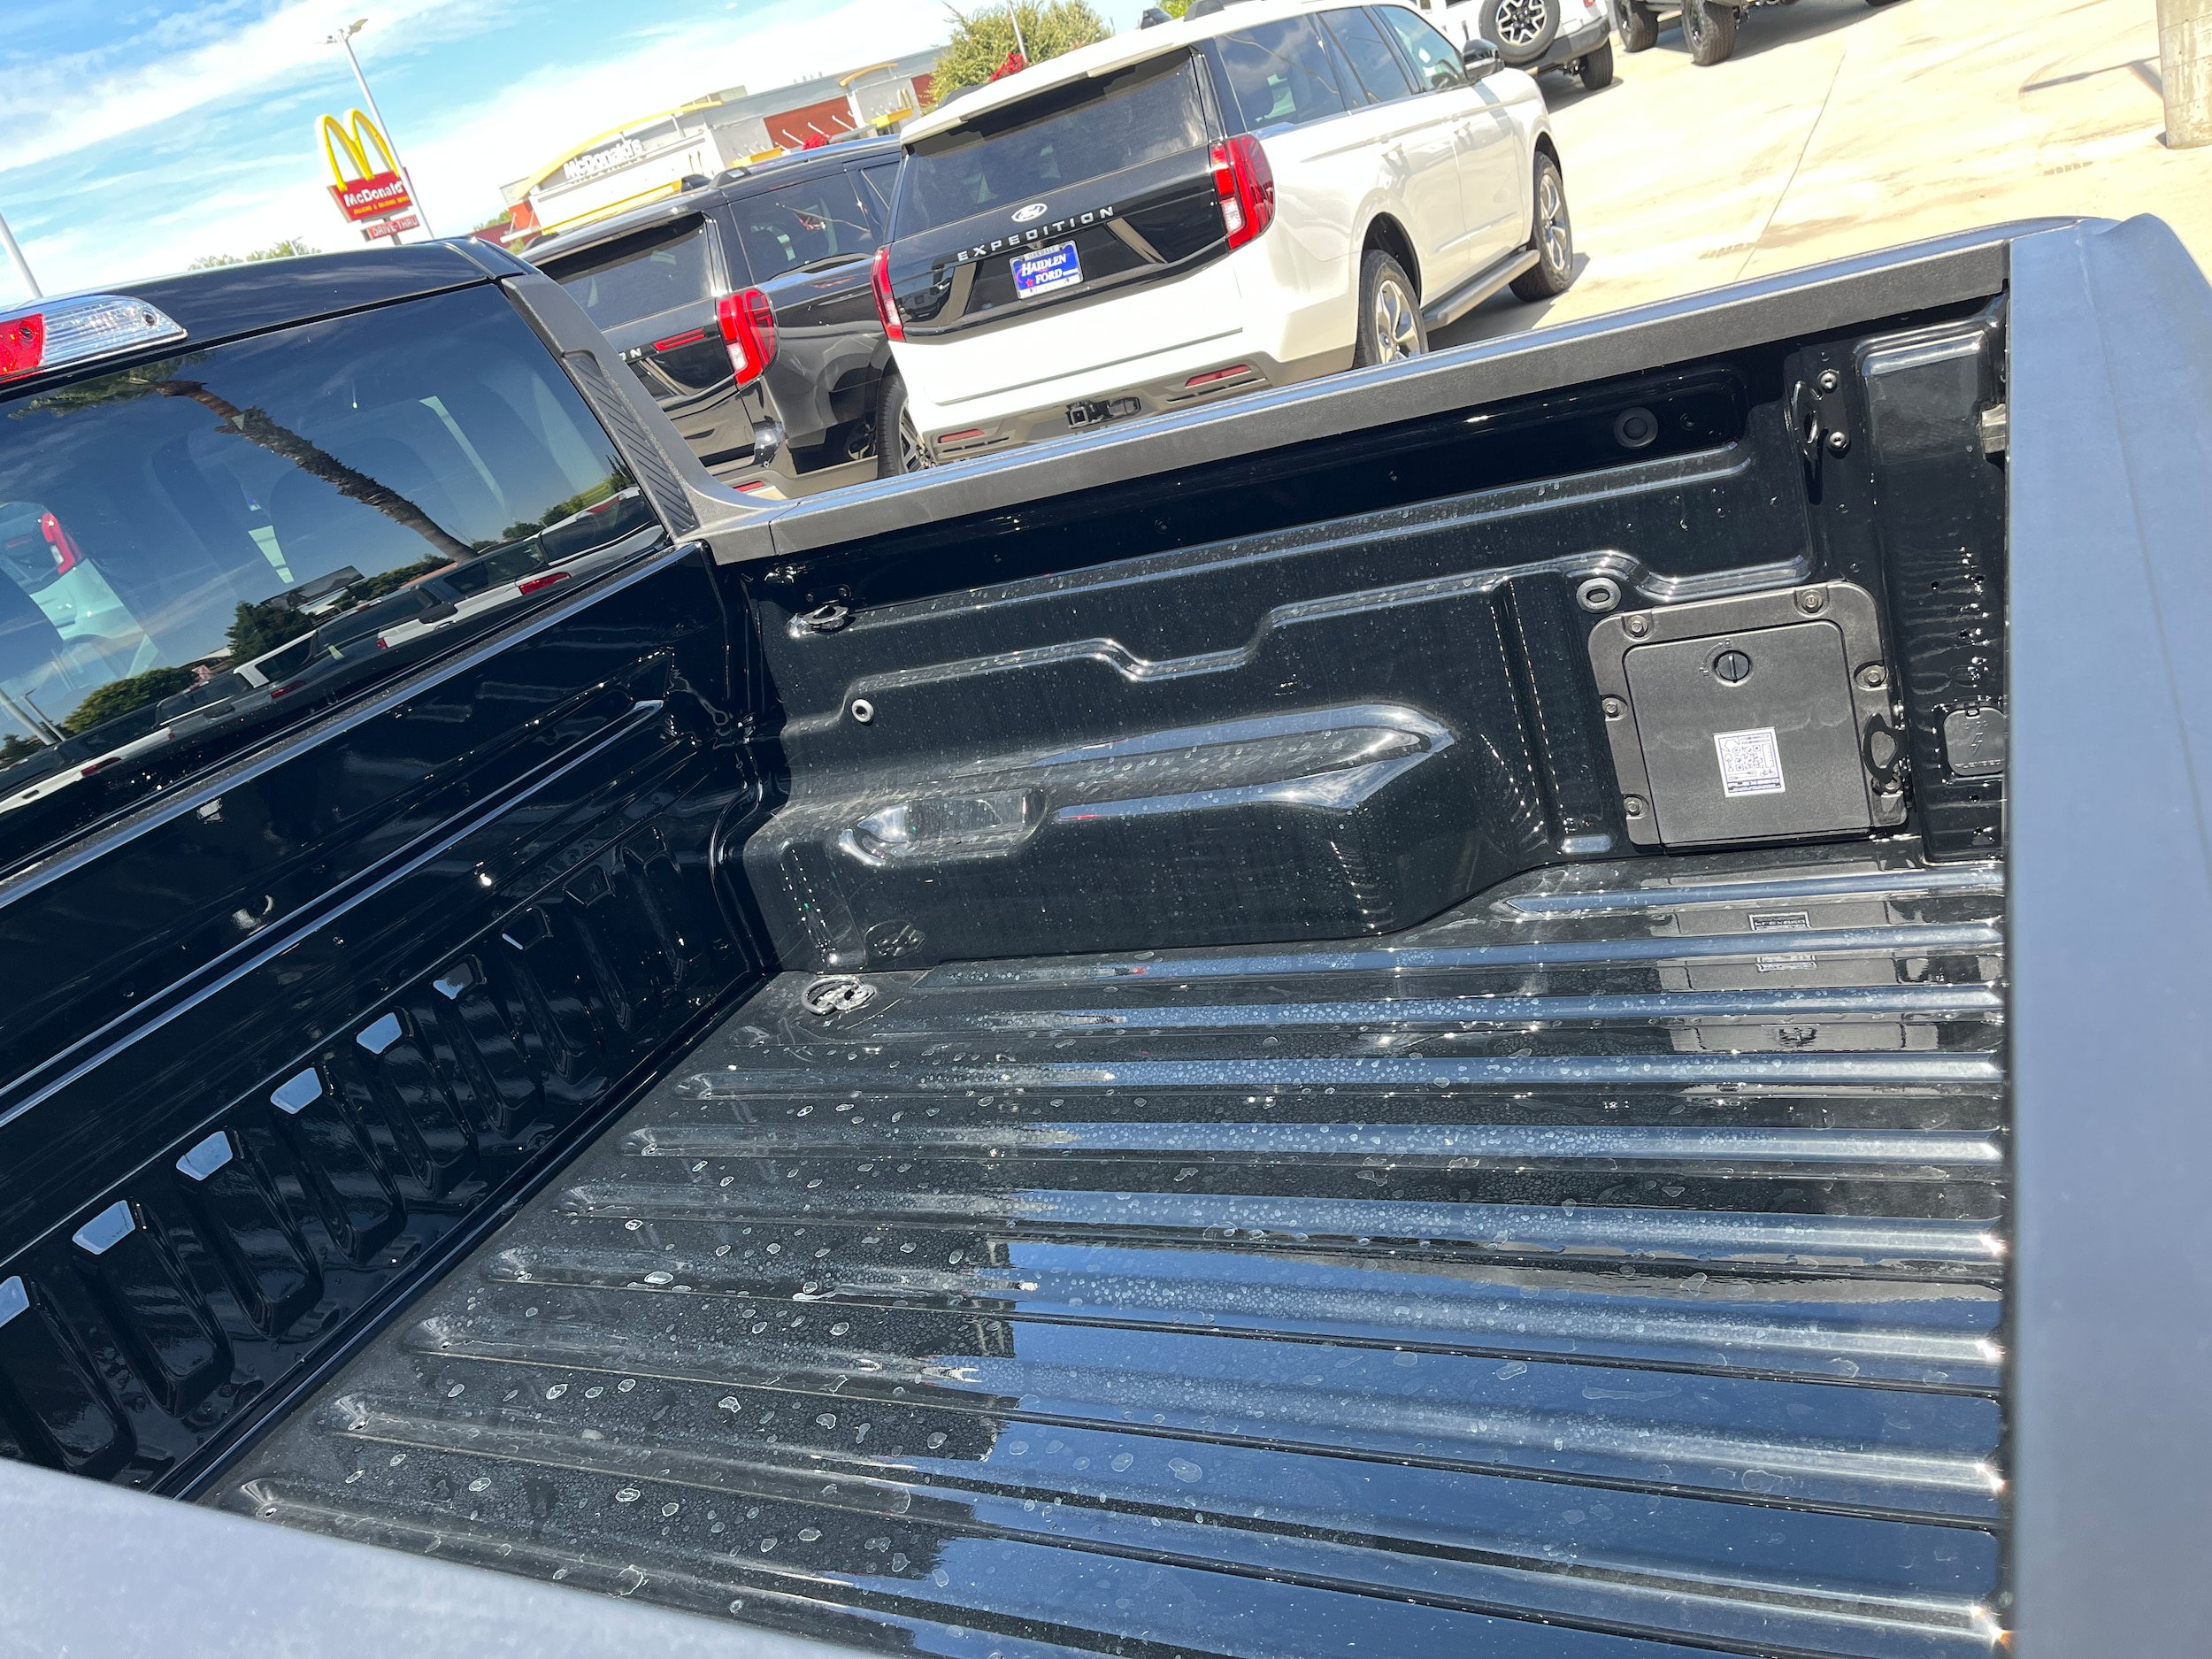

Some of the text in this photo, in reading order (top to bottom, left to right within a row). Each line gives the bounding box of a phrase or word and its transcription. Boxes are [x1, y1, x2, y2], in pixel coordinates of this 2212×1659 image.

[563, 138, 644, 180] McDonald's
[956, 206, 1115, 262] EXPEDITION
[1021, 254, 1067, 277] HAIDLEN
[1034, 268, 1063, 285] FORD
